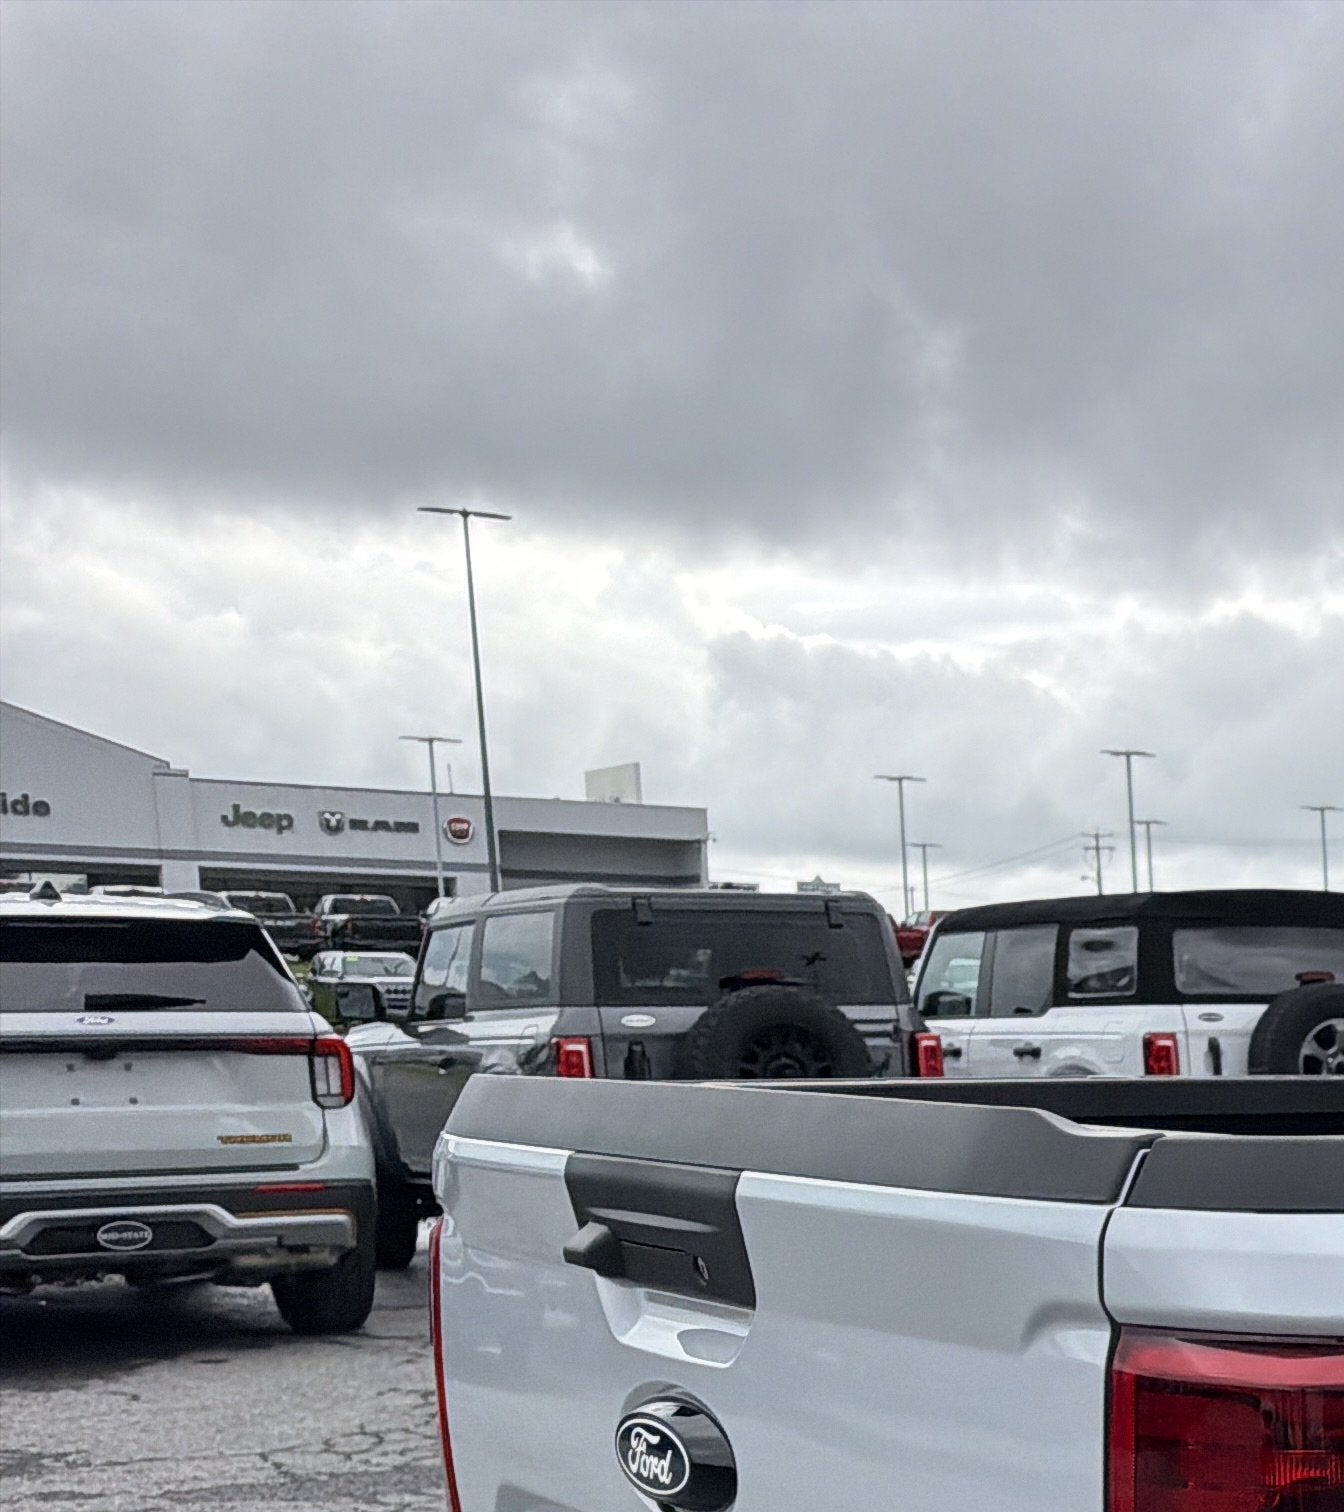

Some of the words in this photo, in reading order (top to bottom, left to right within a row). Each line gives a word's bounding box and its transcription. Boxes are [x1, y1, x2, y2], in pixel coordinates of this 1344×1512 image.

[221, 803, 294, 835] Jeep
[349, 818, 420, 834] RAM
[627, 1426, 673, 1485] Ford
